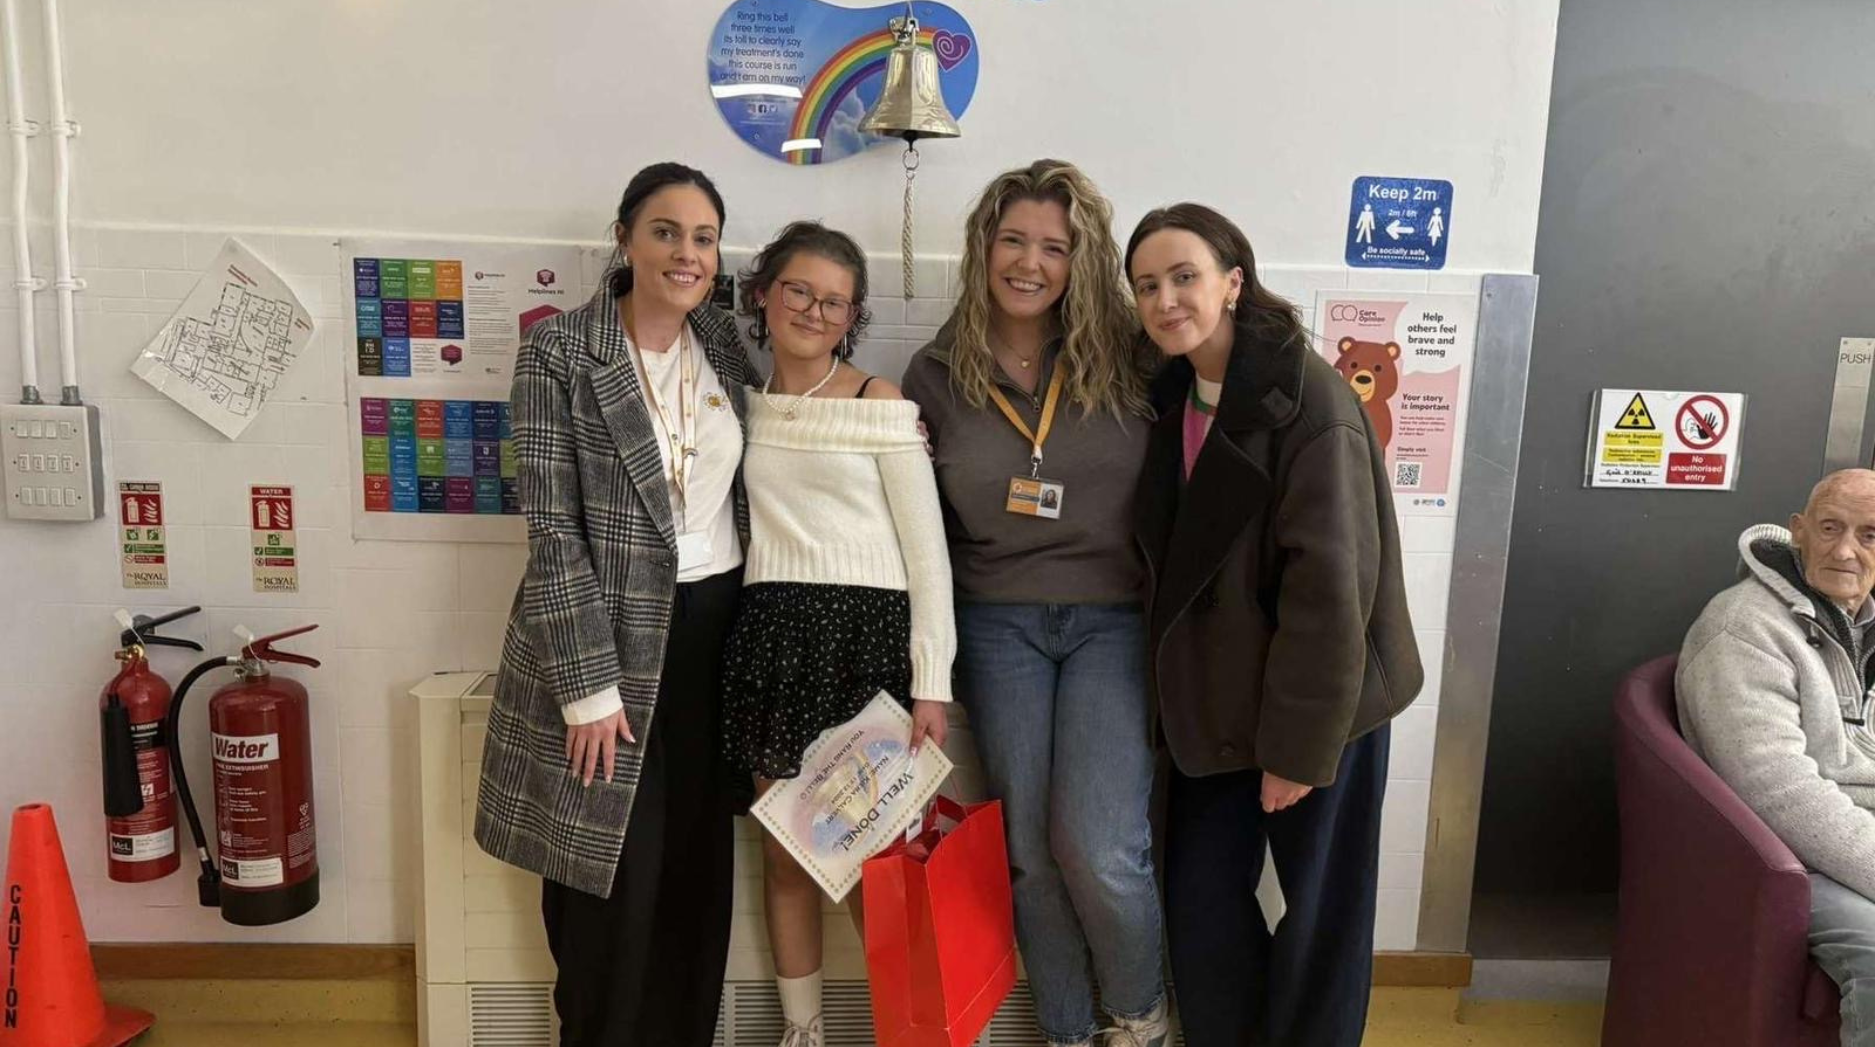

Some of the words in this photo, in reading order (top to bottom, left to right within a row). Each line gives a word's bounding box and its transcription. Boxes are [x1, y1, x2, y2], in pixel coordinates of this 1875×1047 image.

[737, 11, 755, 22] Ring
[757, 12, 771, 20] this
[773, 13, 788, 21] bell
[731, 24, 752, 32] three
[754, 25, 776, 33] times
[778, 26, 795, 34] well
[749, 36, 757, 44] to
[758, 37, 785, 47] clearly
[787, 39, 801, 47] say
[721, 48, 734, 56] my
[736, 48, 780, 57] treatment's
[729, 60, 743, 68] this
[745, 61, 772, 69] course
[721, 72, 737, 80] and
[771, 75, 785, 83] my
[1369, 185, 1409, 202] Keep
[1413, 187, 1437, 200] 2m
[1379, 247, 1408, 256] socially
[1423, 312, 1444, 324] Help
[1408, 324, 1437, 333] others
[1439, 325, 1457, 334] feel
[1408, 335, 1435, 344] brave
[1438, 336, 1455, 345] and
[1415, 347, 1446, 358] strong
[1839, 353, 1872, 364] PUSH
[1403, 393, 1421, 402] Your
[1422, 394, 1443, 403] story
[1409, 402, 1450, 412] important
[1692, 455, 1703, 463] No
[1670, 464, 1723, 473] unauthorised
[1685, 474, 1706, 482] entry
[134, 571, 166, 581] ROYAL
[264, 575, 295, 585] ROYAL
[850, 730, 864, 744] YOU
[215, 737, 269, 759] Water
[834, 742, 852, 762] RANG
[822, 761, 836, 774] THE
[877, 772, 914, 806] WELL
[842, 807, 880, 851] DONE!
[5, 885, 21, 1028] CAUTION
